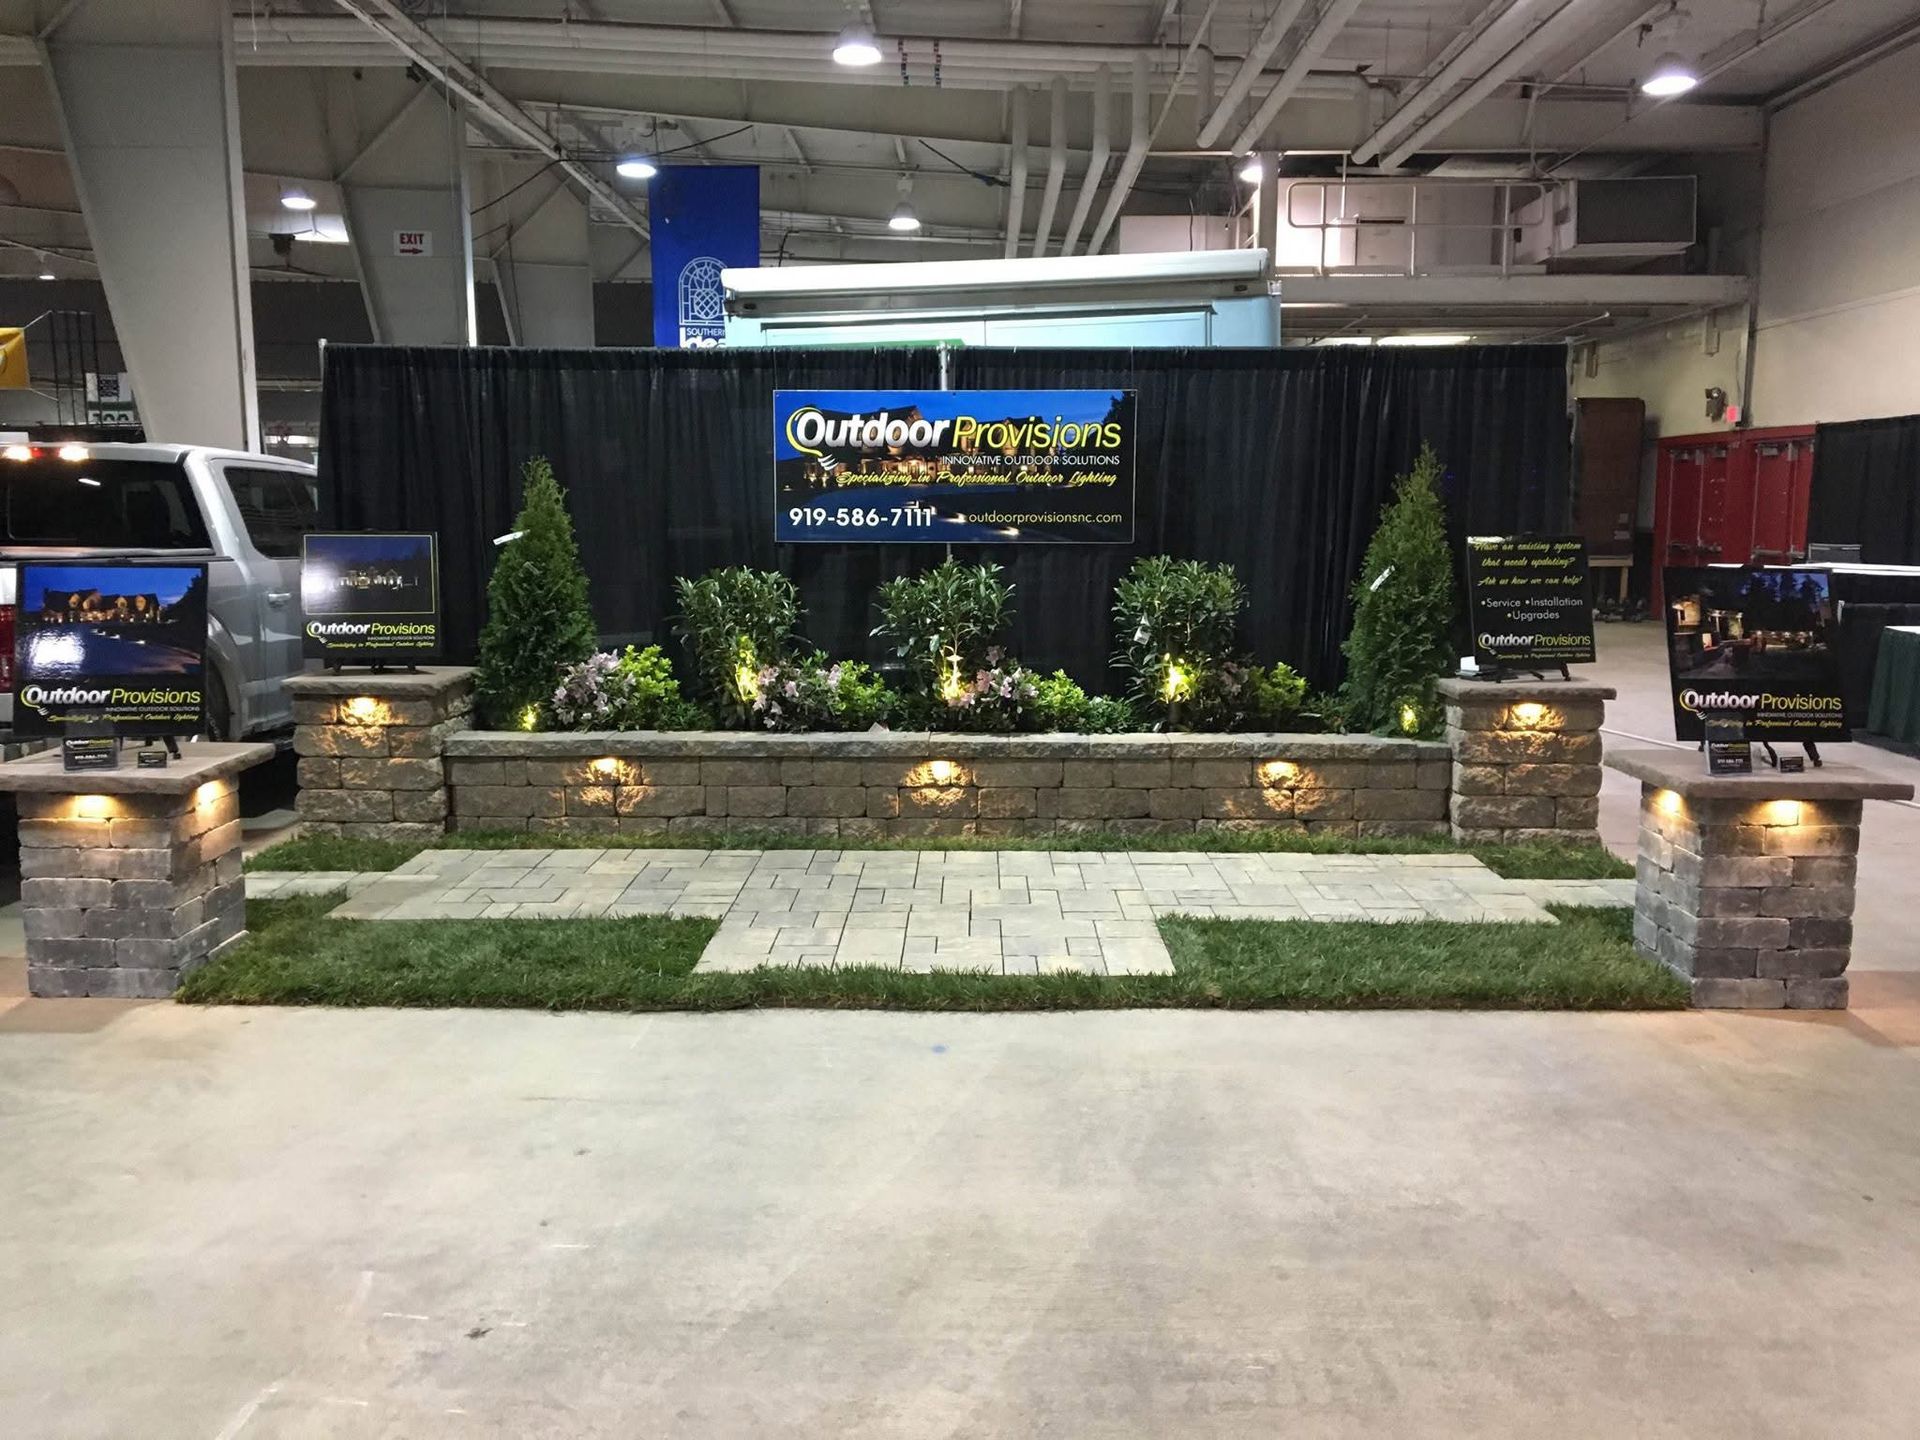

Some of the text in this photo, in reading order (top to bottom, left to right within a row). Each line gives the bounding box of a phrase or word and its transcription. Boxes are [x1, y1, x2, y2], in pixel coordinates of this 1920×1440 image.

[400, 233, 424, 244] EXIT
[796, 411, 1122, 448] Outdoor Provisions
[942, 455, 1120, 465] INNOVATIVE OUTDOOR SOLUTIONS
[836, 470, 1117, 487] Specializing in Professional Outdoor Lighting
[789, 507, 1122, 527] 919-586-7111 outdoorprovisionsnc.com
[1517, 542, 1551, 552] existing
[1554, 542, 1582, 553] system
[1481, 557, 1576, 568] that needs updating?
[1477, 576, 1497, 586] Ask
[1511, 576, 1529, 585] how
[311, 622, 436, 635] Outdoor Provisions
[1482, 633, 1591, 646] Outdoor Provisions
[26, 686, 201, 705] Outdoor Provisions
[1685, 691, 1842, 710] Outdoor Provisions
